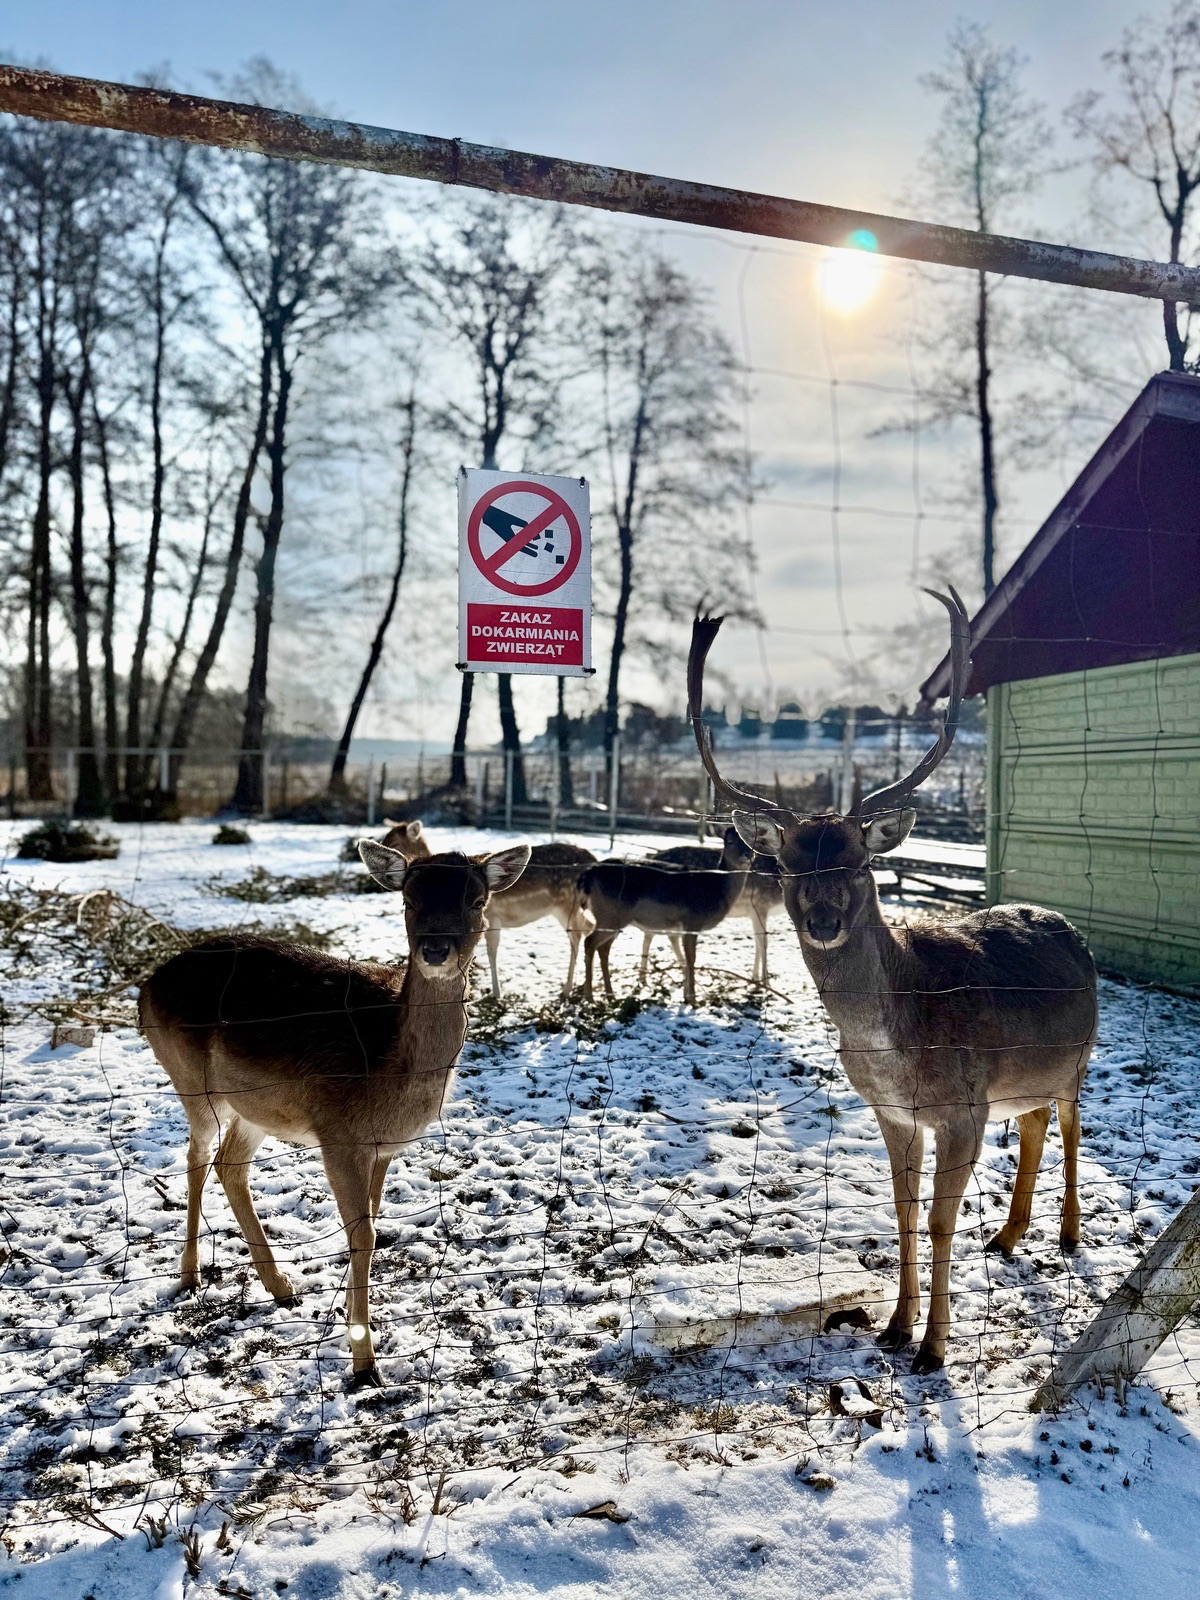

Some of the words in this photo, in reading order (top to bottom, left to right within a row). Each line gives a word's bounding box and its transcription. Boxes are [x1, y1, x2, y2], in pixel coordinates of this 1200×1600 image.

[500, 611, 552, 625] ZAKAZ
[471, 625, 580, 641] DOKARMIANIA
[486, 641, 565, 657] ZWIERZĄT
